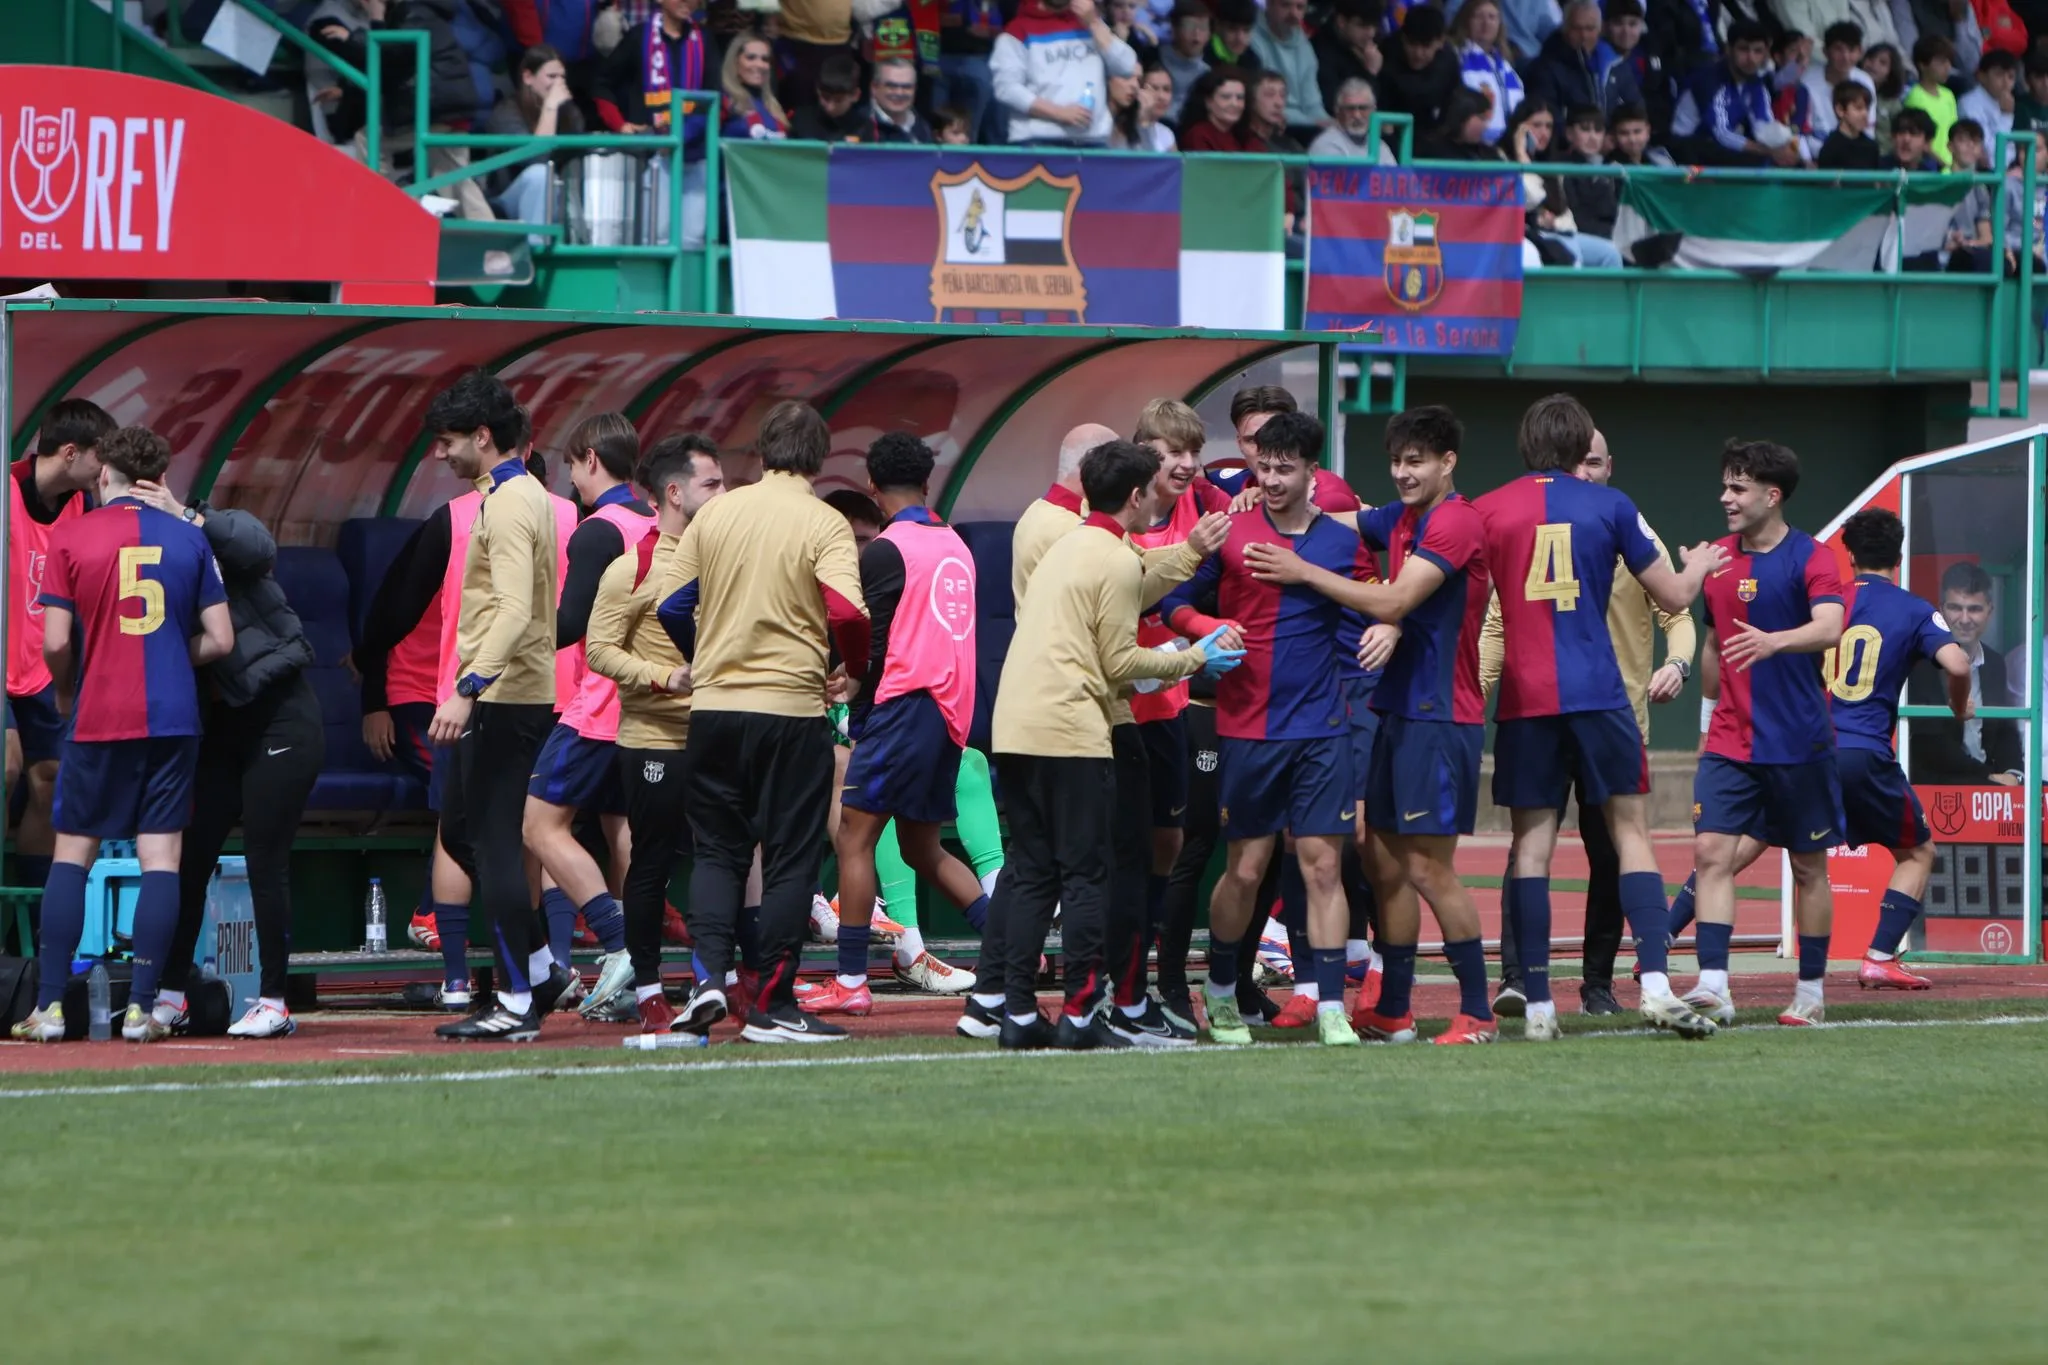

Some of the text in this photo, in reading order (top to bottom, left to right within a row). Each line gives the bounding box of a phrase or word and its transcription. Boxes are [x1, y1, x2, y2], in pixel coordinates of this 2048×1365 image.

[19, 116, 186, 252] DEL REY
[1369, 172, 1516, 201] BARCELONISTA
[1406, 320, 1427, 346] la
[119, 546, 165, 636] 5
[1525, 523, 1580, 612] 4
[1972, 791, 2013, 821] COPA
[216, 920, 254, 975] PRIME
